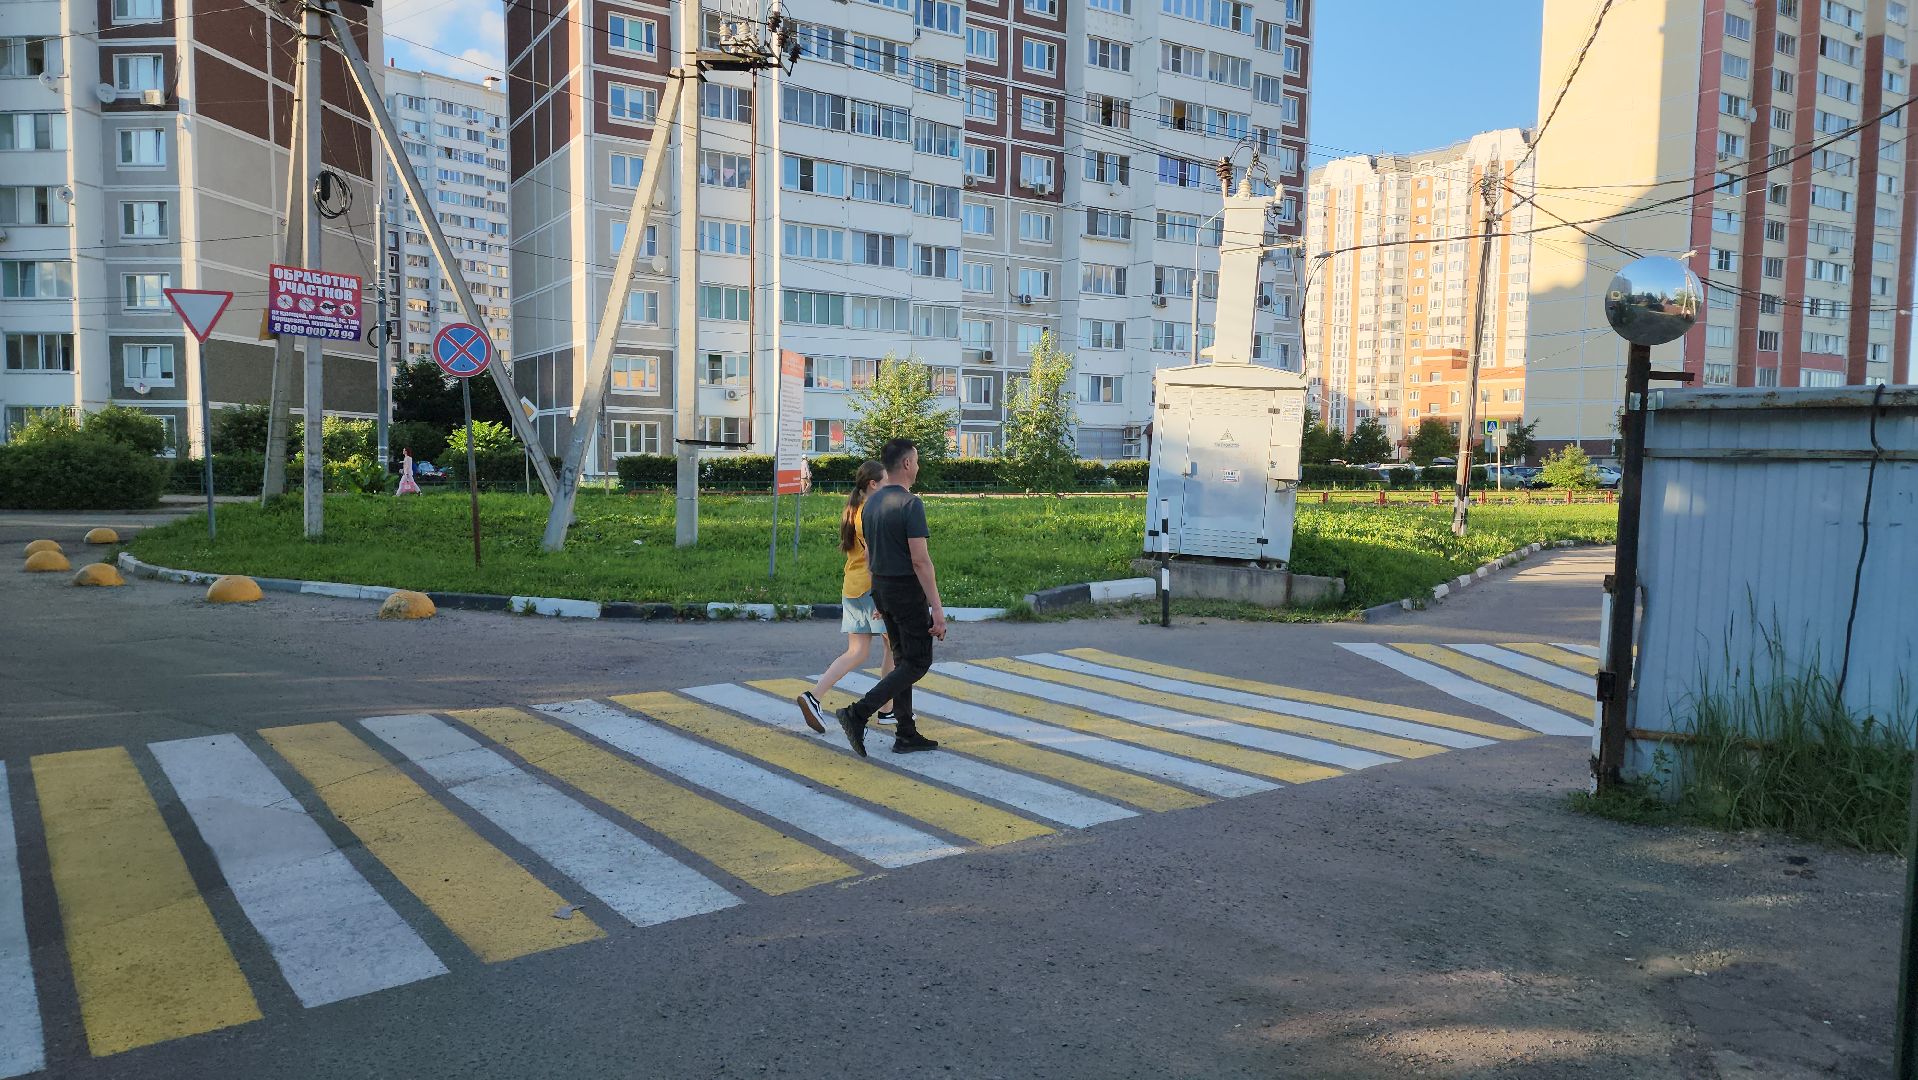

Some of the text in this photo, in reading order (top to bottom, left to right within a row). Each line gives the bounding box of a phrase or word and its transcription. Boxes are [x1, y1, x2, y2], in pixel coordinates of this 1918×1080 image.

[274, 268, 358, 289] ОБРАБОТКА
[278, 281, 353, 301] УЧАСТКОВ
[274, 322, 281, 332] 8
[283, 323, 305, 334] 999
[341, 330, 354, 339] 99
